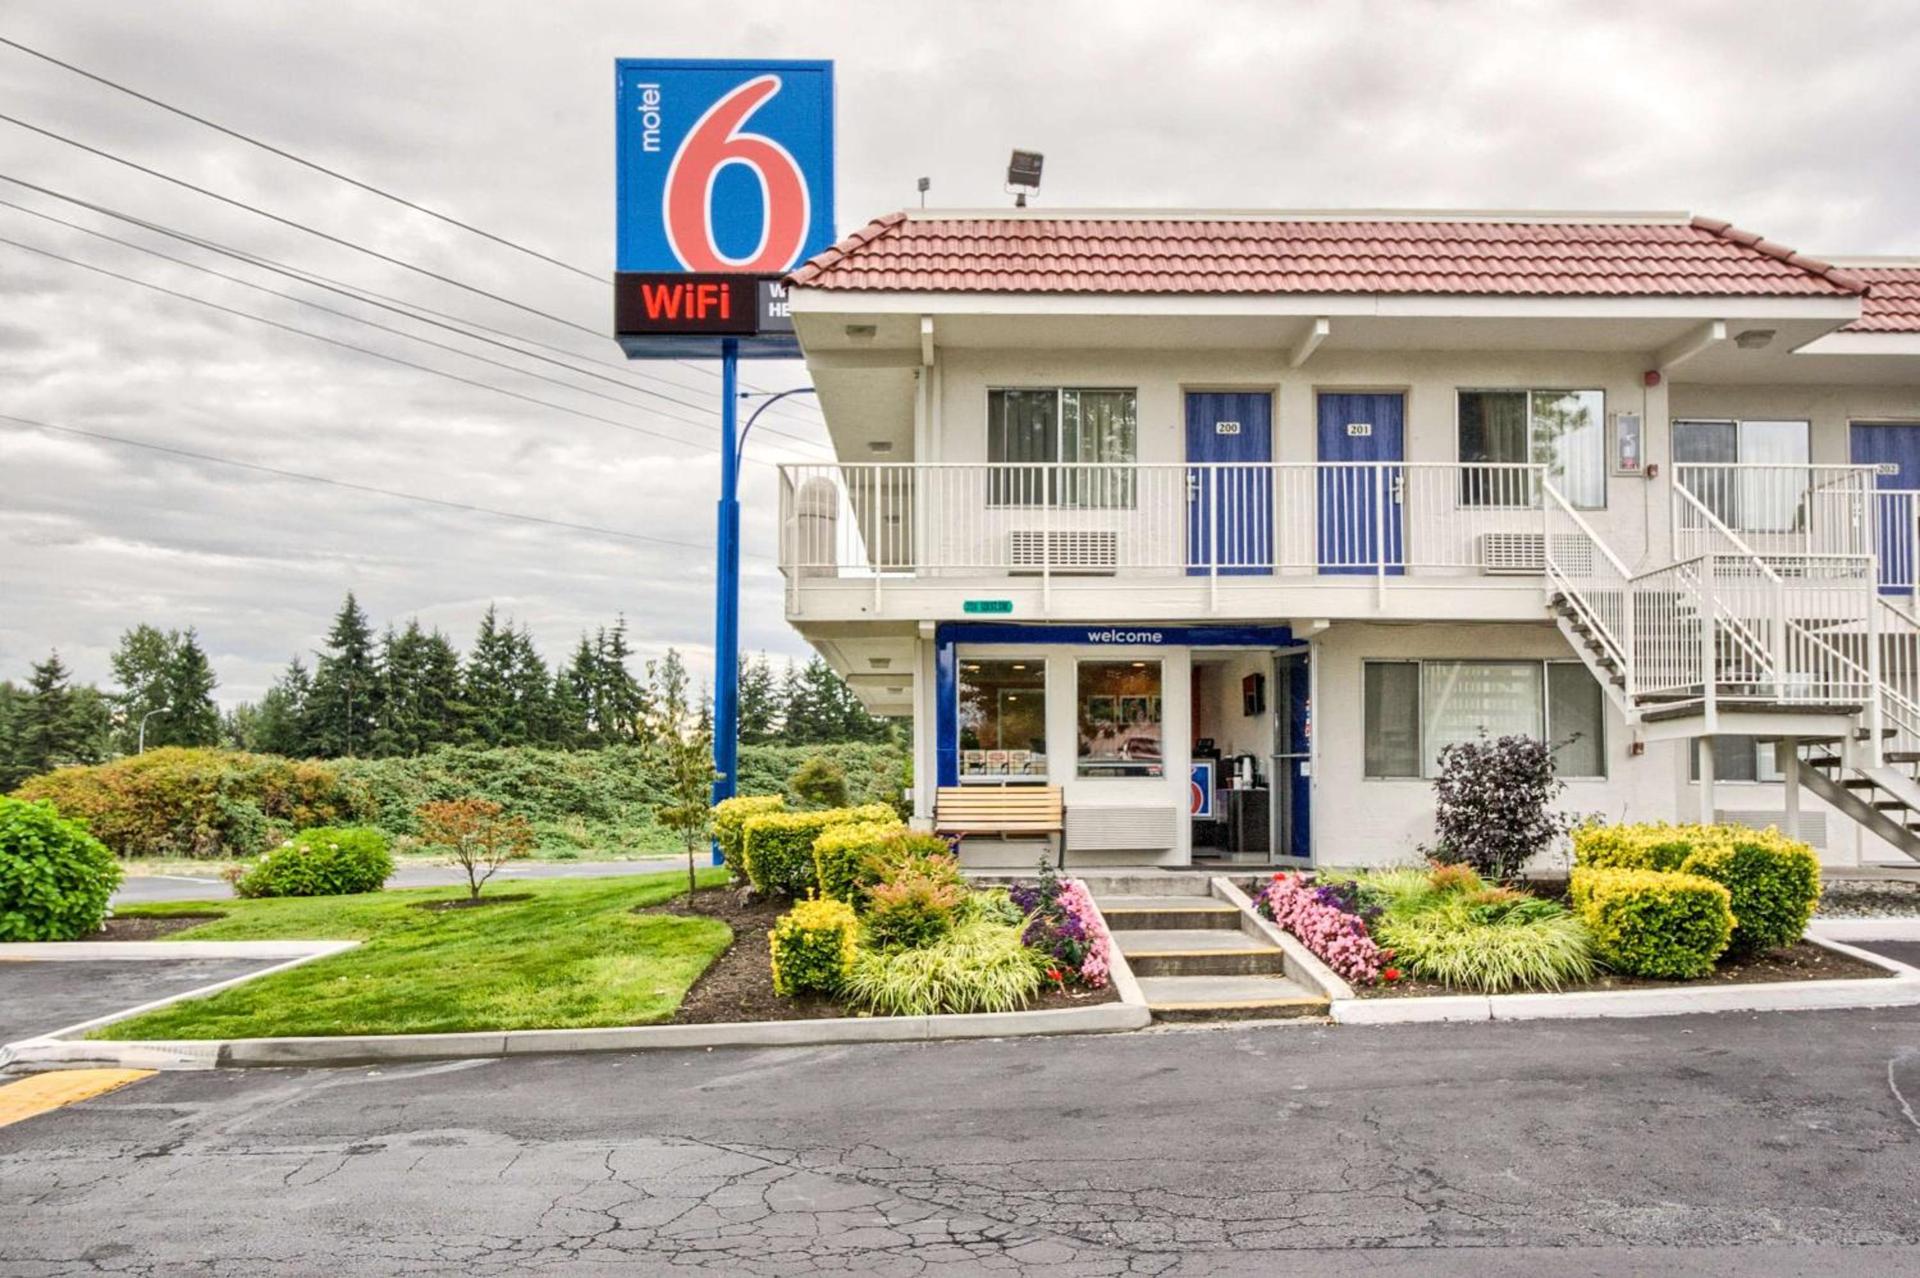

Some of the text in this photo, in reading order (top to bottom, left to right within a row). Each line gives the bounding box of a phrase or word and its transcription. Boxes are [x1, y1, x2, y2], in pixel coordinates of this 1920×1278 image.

[637, 83, 661, 152] motel
[664, 74, 811, 273] 6
[642, 283, 730, 319] WiFi
[1218, 423, 1238, 433] 200
[1350, 425, 1369, 435] 201
[1087, 629, 1163, 644] welcome
